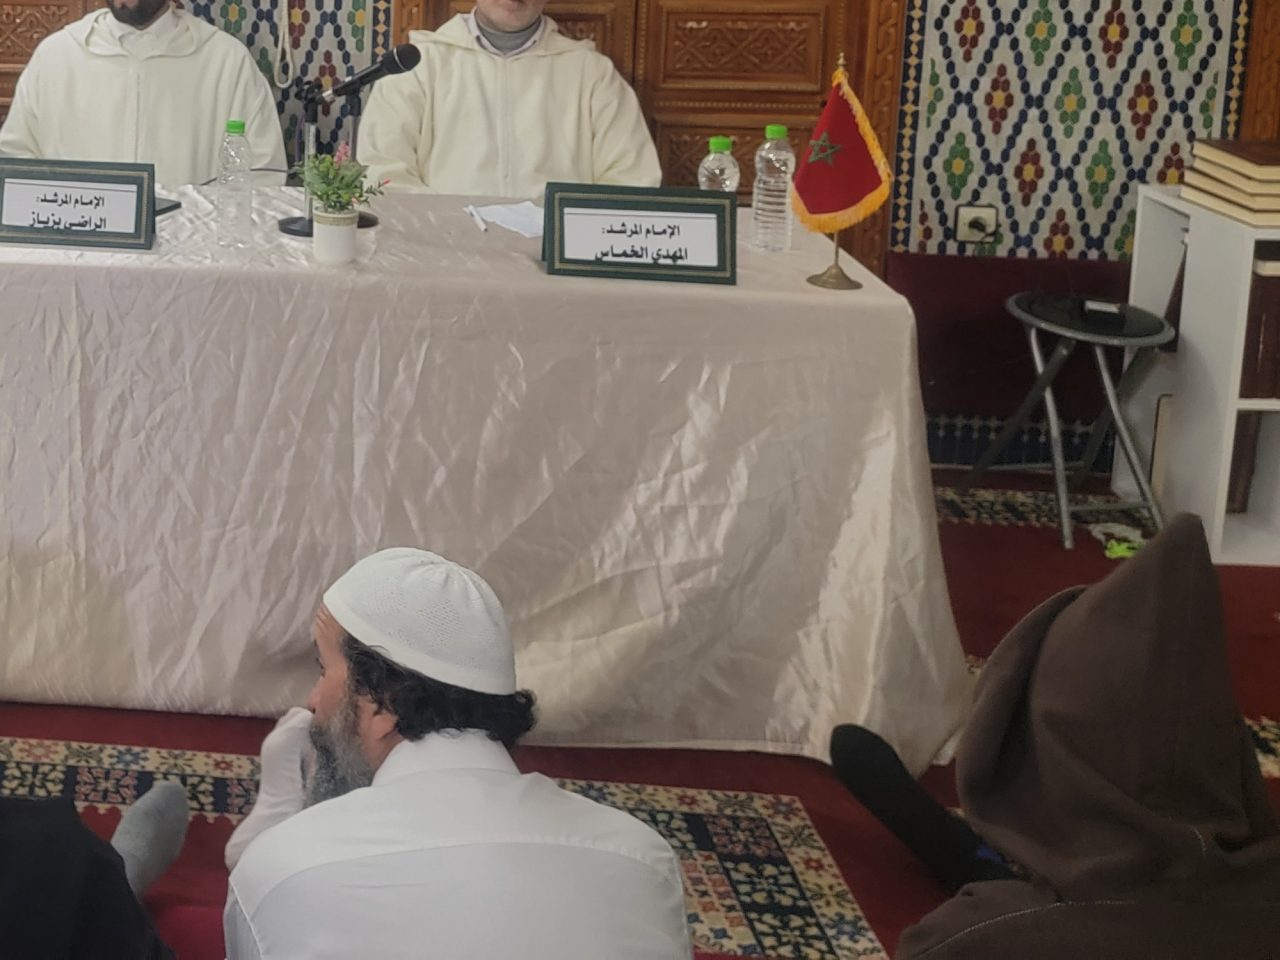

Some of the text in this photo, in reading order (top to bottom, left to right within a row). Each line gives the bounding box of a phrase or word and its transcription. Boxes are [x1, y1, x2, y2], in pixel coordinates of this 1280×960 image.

[73, 193, 105, 210] الإمام
[645, 223, 680, 240] الإمام
[651, 247, 688, 263] المهدي
